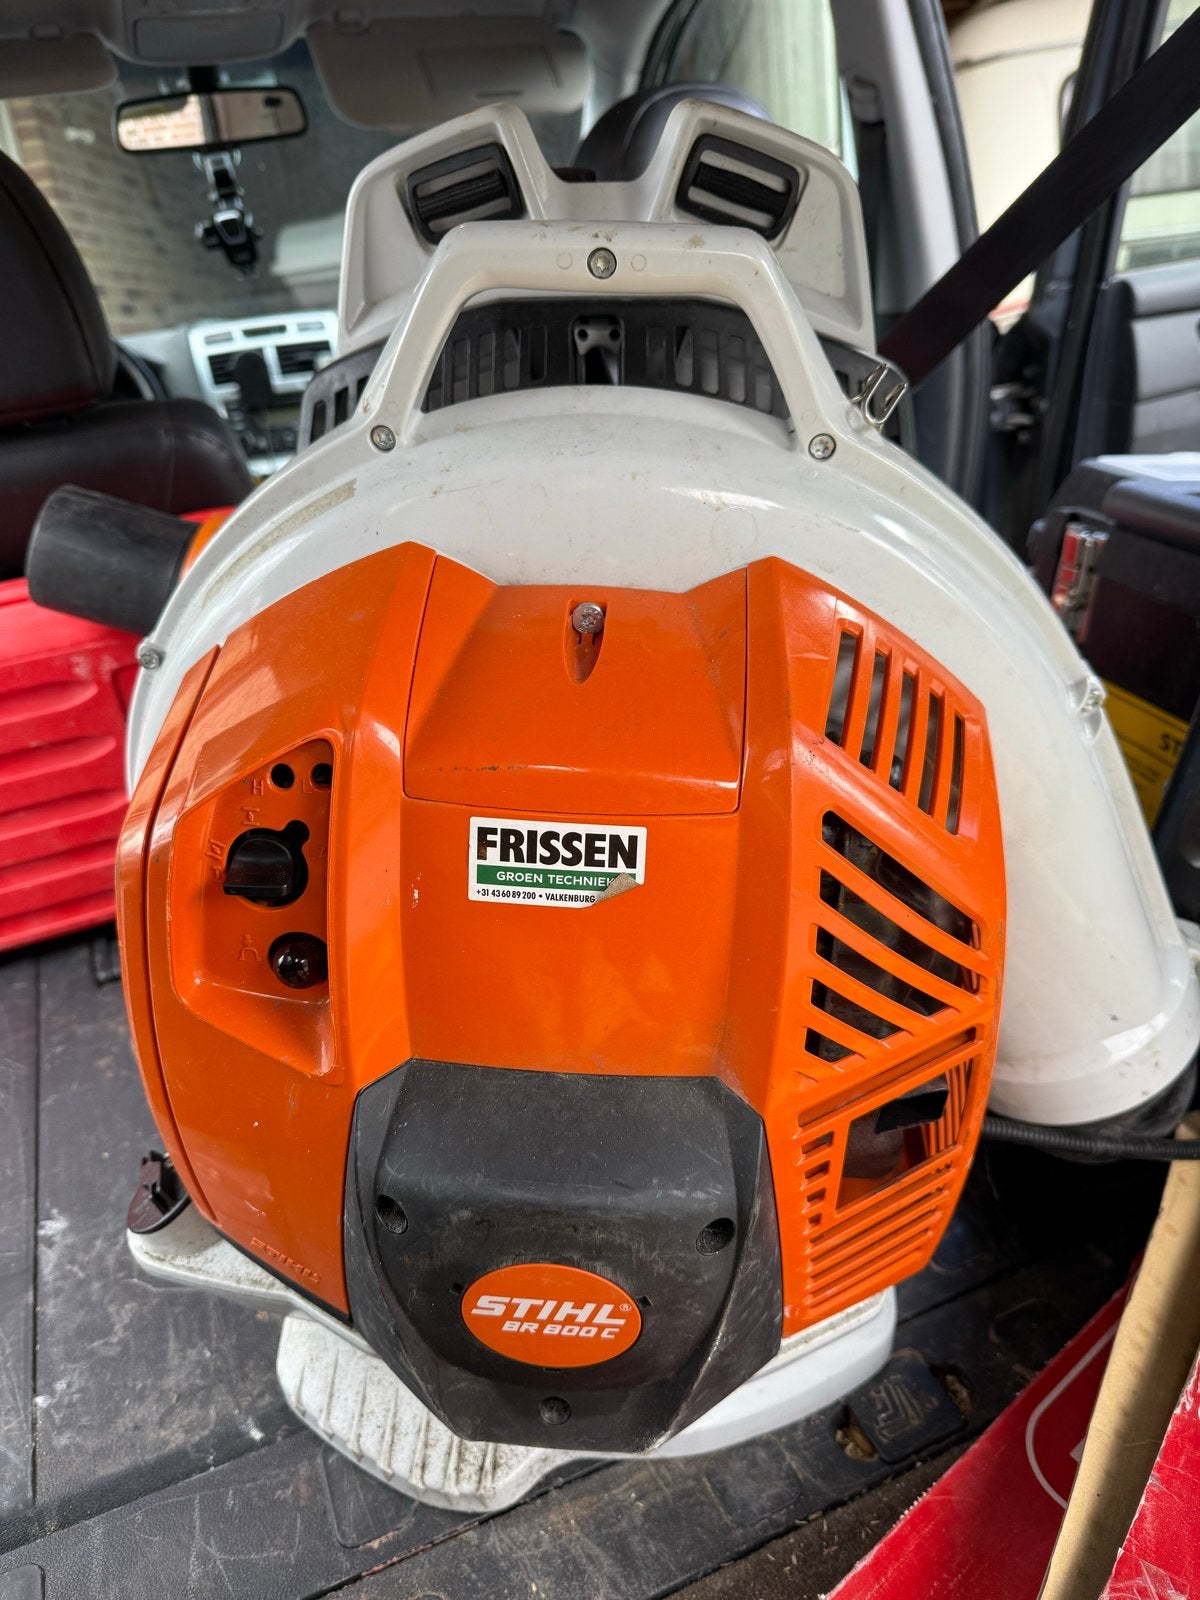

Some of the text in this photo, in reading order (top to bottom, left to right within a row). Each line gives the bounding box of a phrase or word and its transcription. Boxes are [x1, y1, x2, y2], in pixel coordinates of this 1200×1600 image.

[477, 826, 639, 870] FRISSEN
[496, 870, 543, 885] GROEN
[476, 888, 489, 897] +31
[545, 892, 596, 903] VALKENBURG
[501, 1320, 620, 1340] BR 800 C
